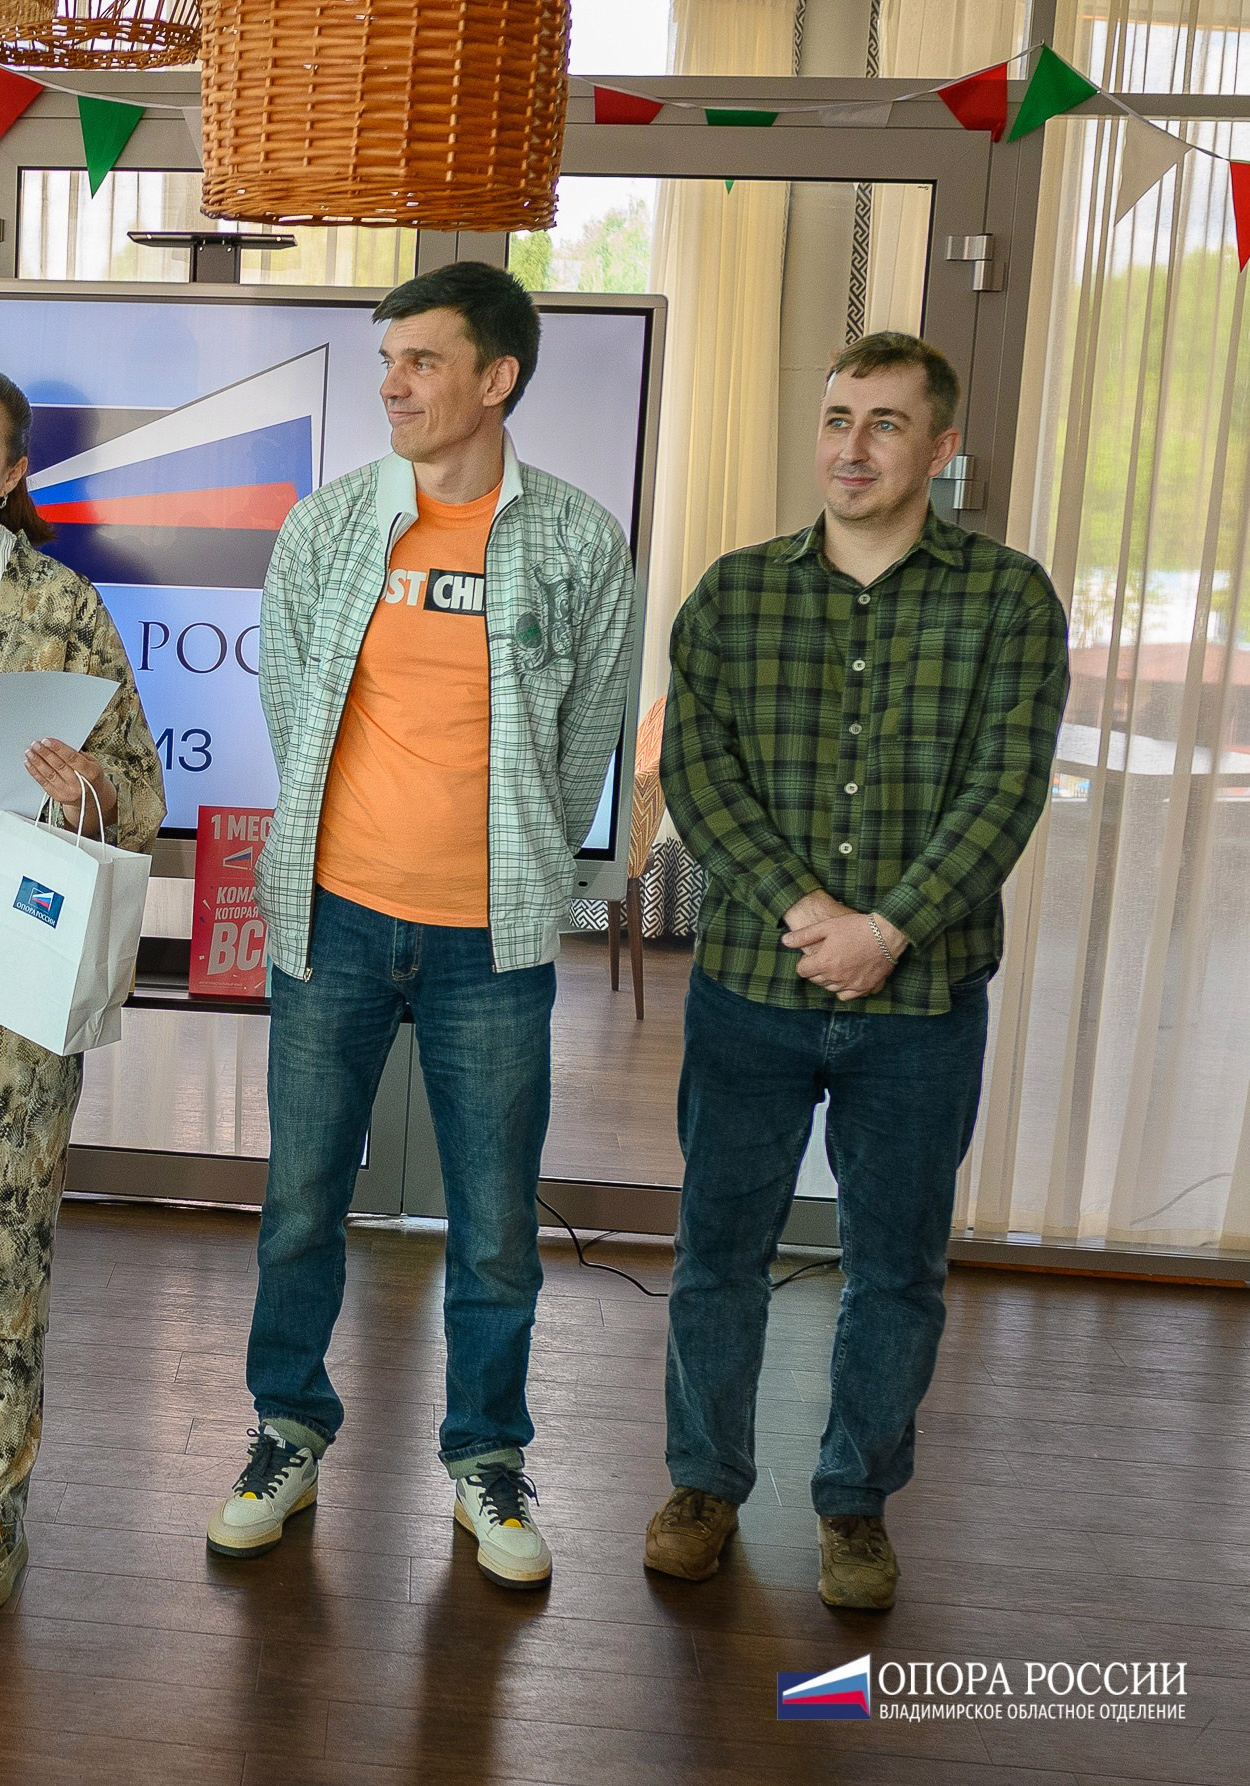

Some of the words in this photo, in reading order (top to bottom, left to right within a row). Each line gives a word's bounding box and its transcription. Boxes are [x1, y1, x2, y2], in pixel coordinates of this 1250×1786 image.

[385, 568, 428, 606] ST
[432, 574, 485, 611] CHI
[211, 814, 221, 839] 1
[214, 905, 259, 920] КОТОРАЯ
[207, 919, 269, 976] ВС
